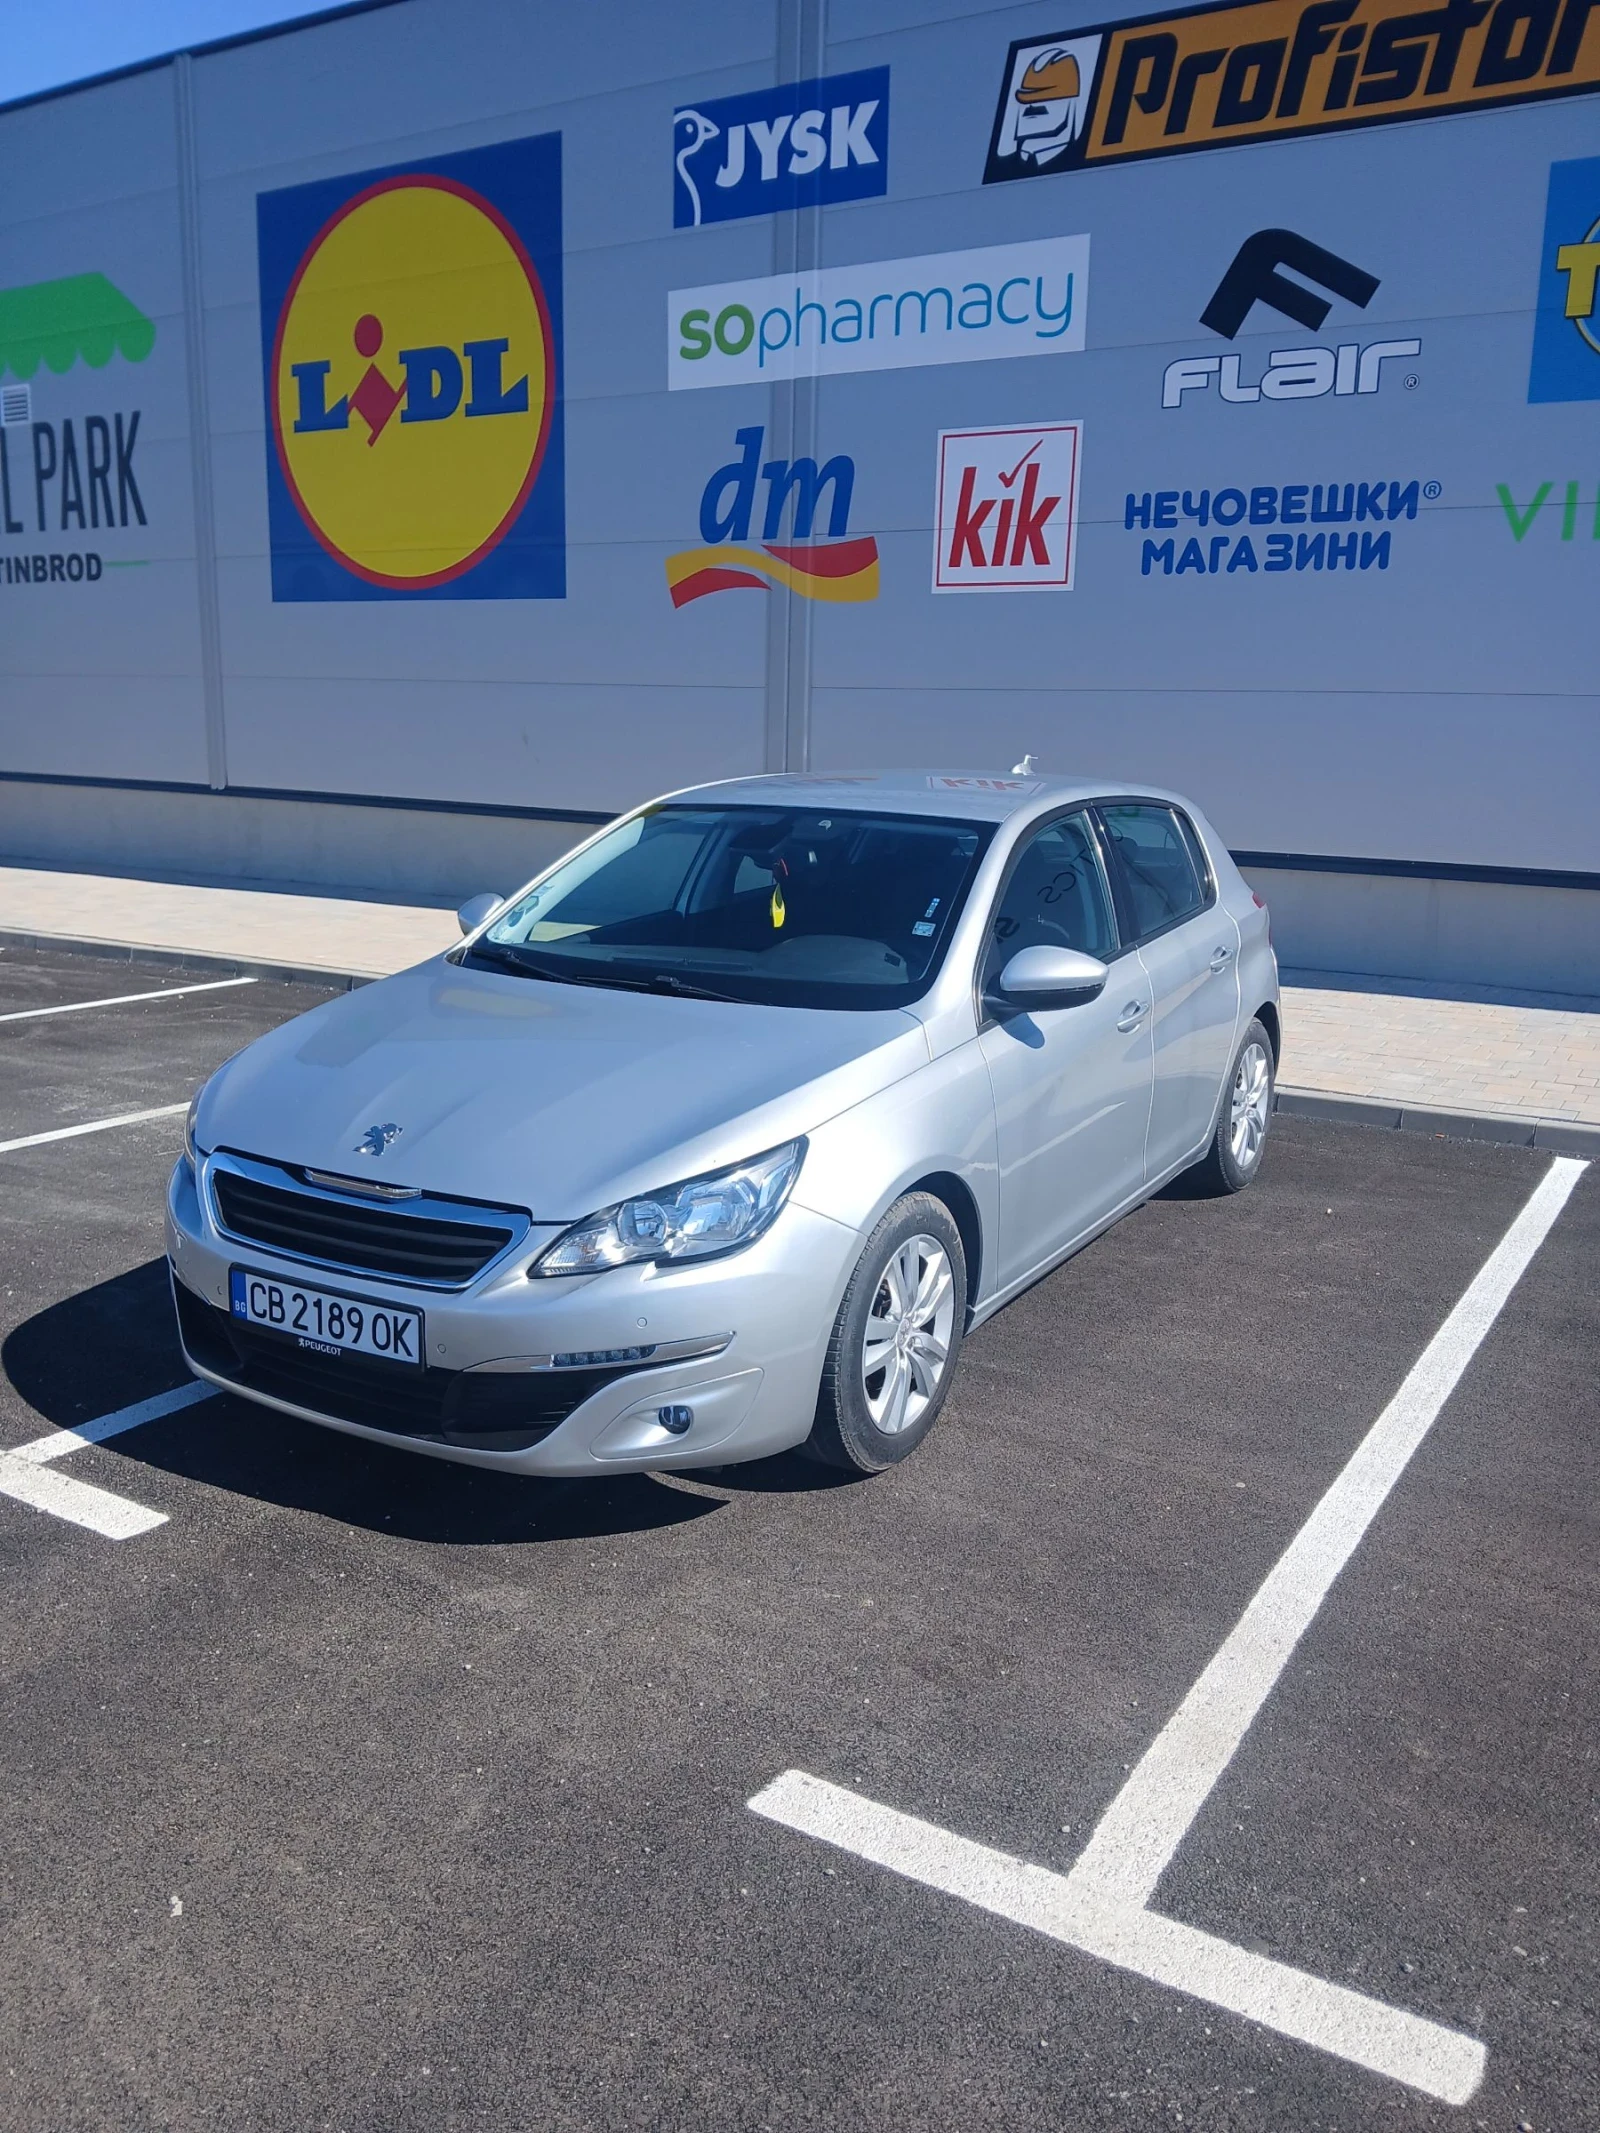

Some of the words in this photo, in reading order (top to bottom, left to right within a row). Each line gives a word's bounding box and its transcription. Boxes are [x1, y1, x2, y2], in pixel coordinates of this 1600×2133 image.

[715, 99, 881, 188] JYSK
[679, 272, 1074, 368] sopharmacy
[32, 410, 148, 532] PARK
[700, 425, 855, 544] dm
[1141, 531, 1391, 576] МАГАЗИНИ
[234, 1300, 247, 1314] BG
[250, 1281, 286, 1325] CB
[291, 1292, 365, 1345] 2189
[371, 1312, 415, 1358] OK
[304, 1339, 342, 1356] PEUGEOT
